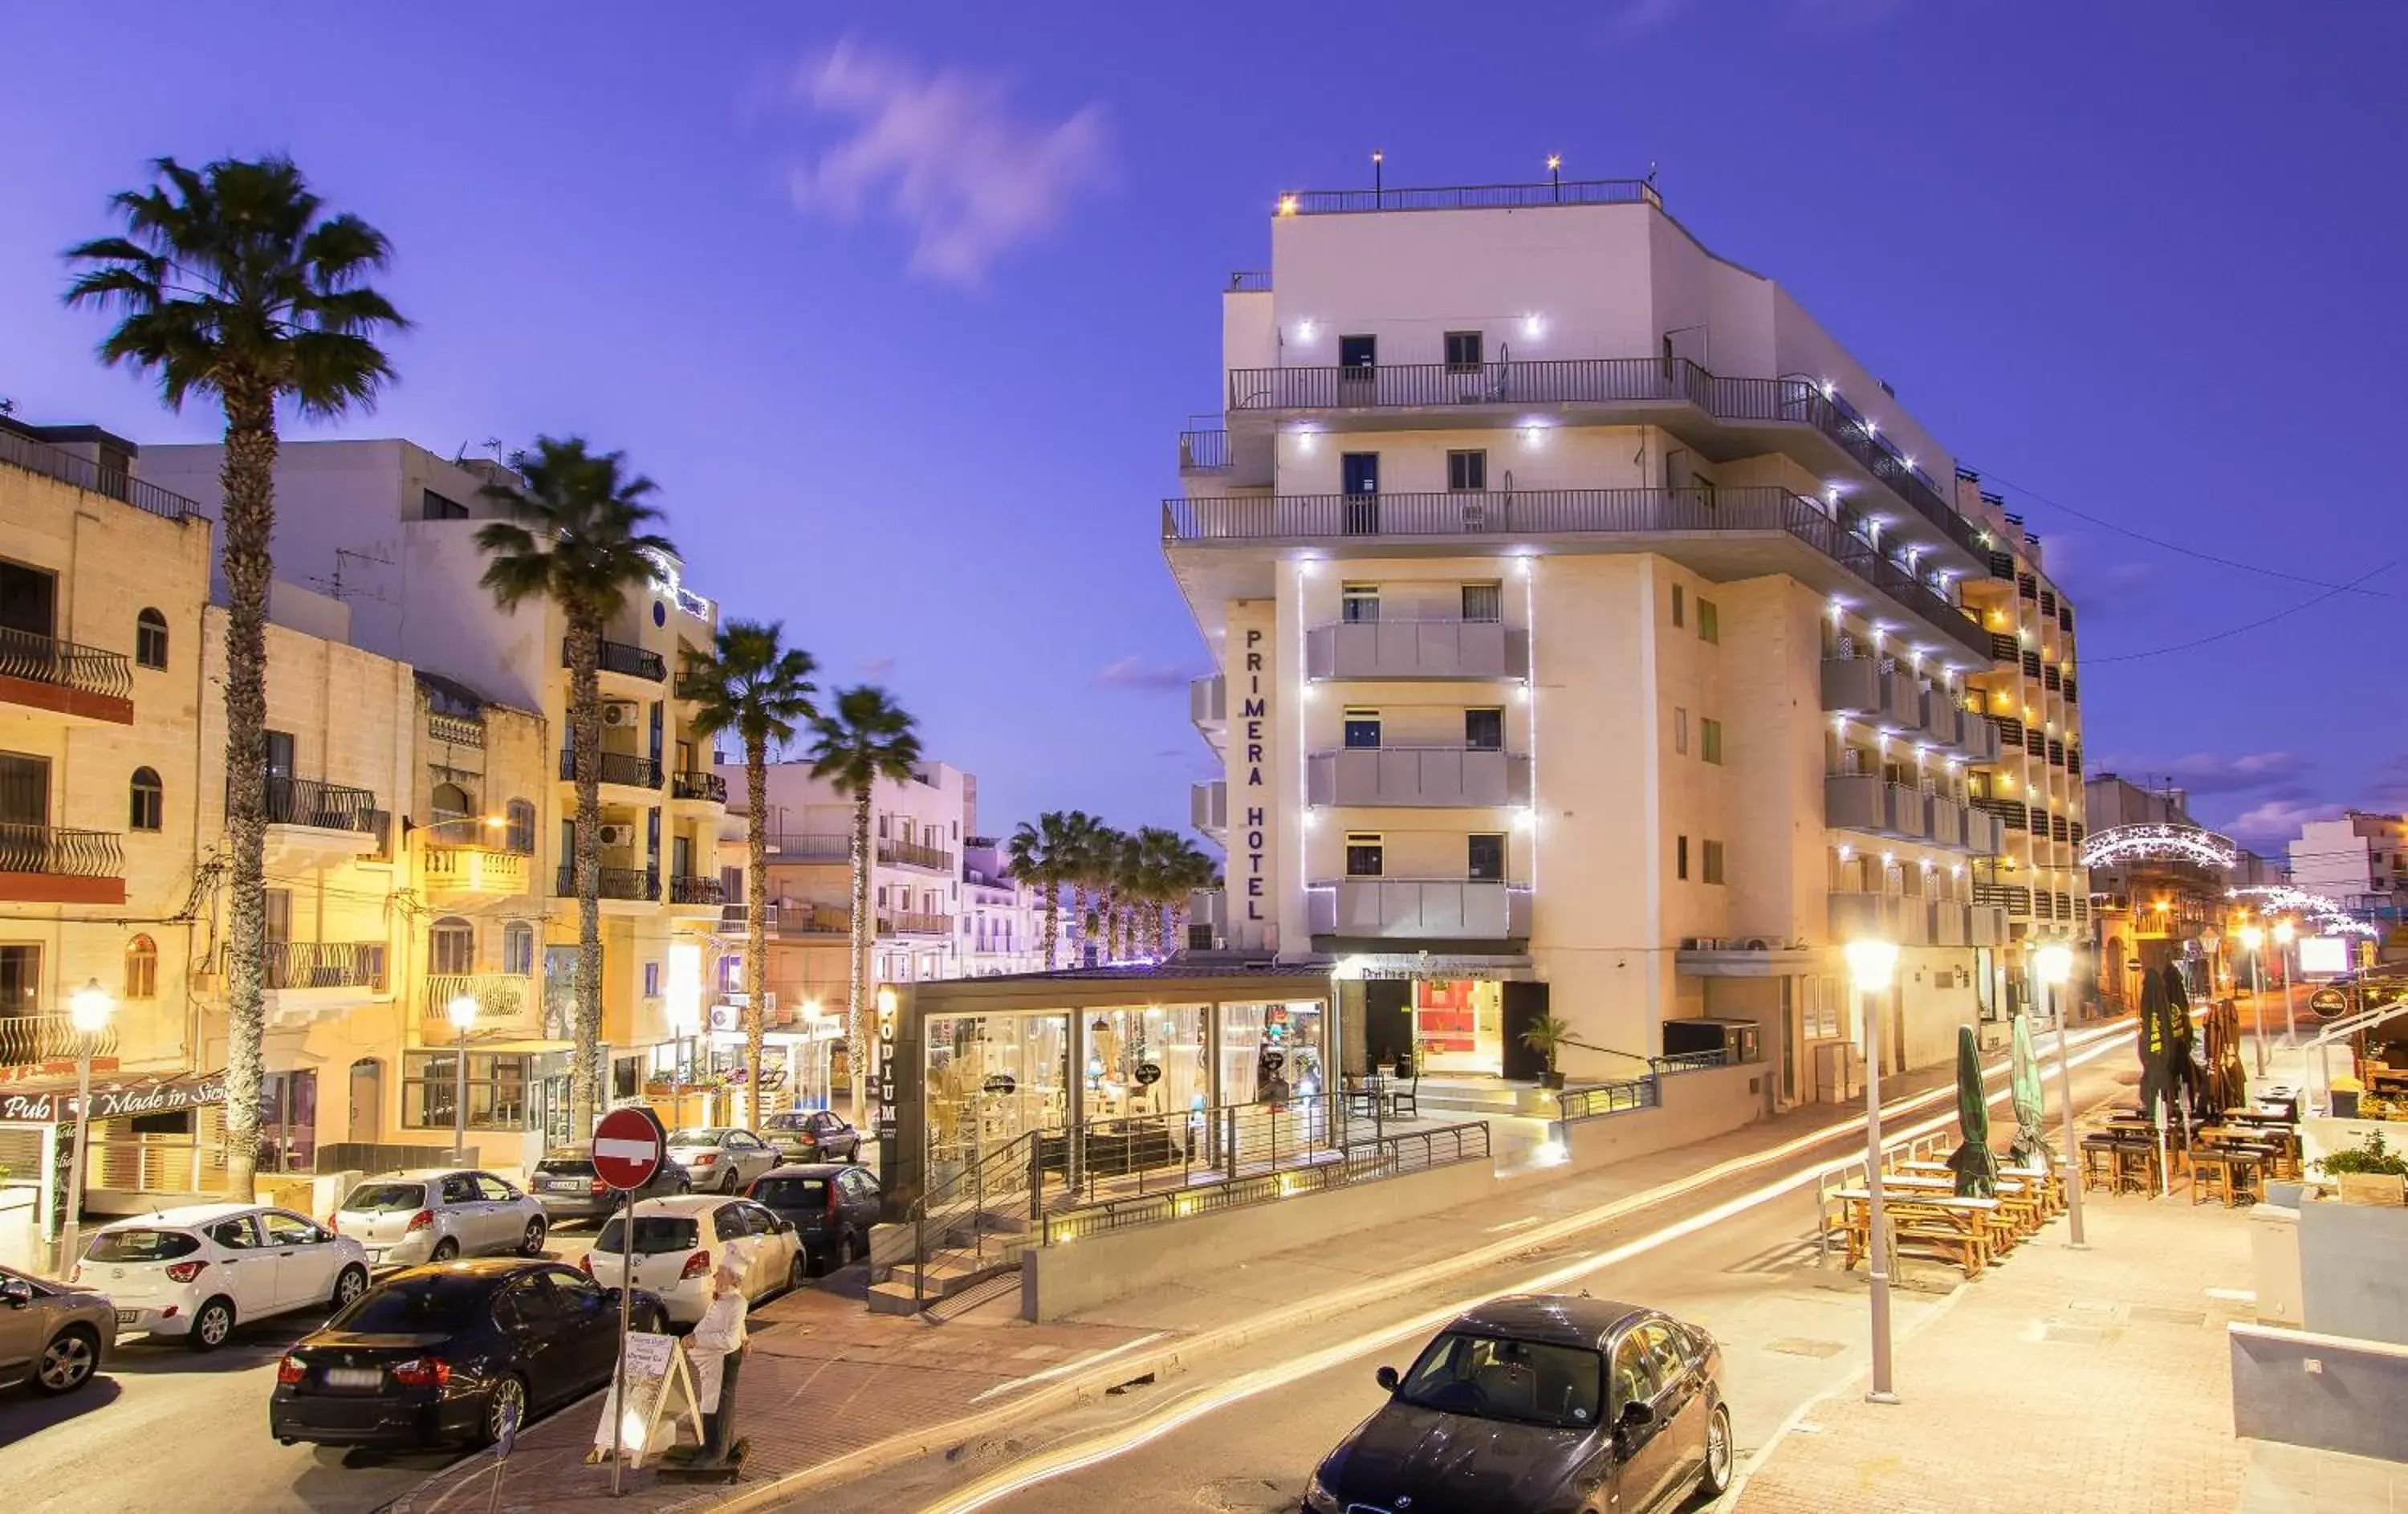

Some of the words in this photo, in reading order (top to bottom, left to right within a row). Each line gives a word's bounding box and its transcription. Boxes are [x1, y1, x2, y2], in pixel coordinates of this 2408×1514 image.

[1245, 631, 1265, 786] PRIMERA
[1248, 808, 1264, 921] HOTEL
[5, 1093, 51, 1119] Pub
[101, 1085, 163, 1115] Made
[168, 1089, 187, 1107] in
[881, 1007, 897, 1121] ODIUM
